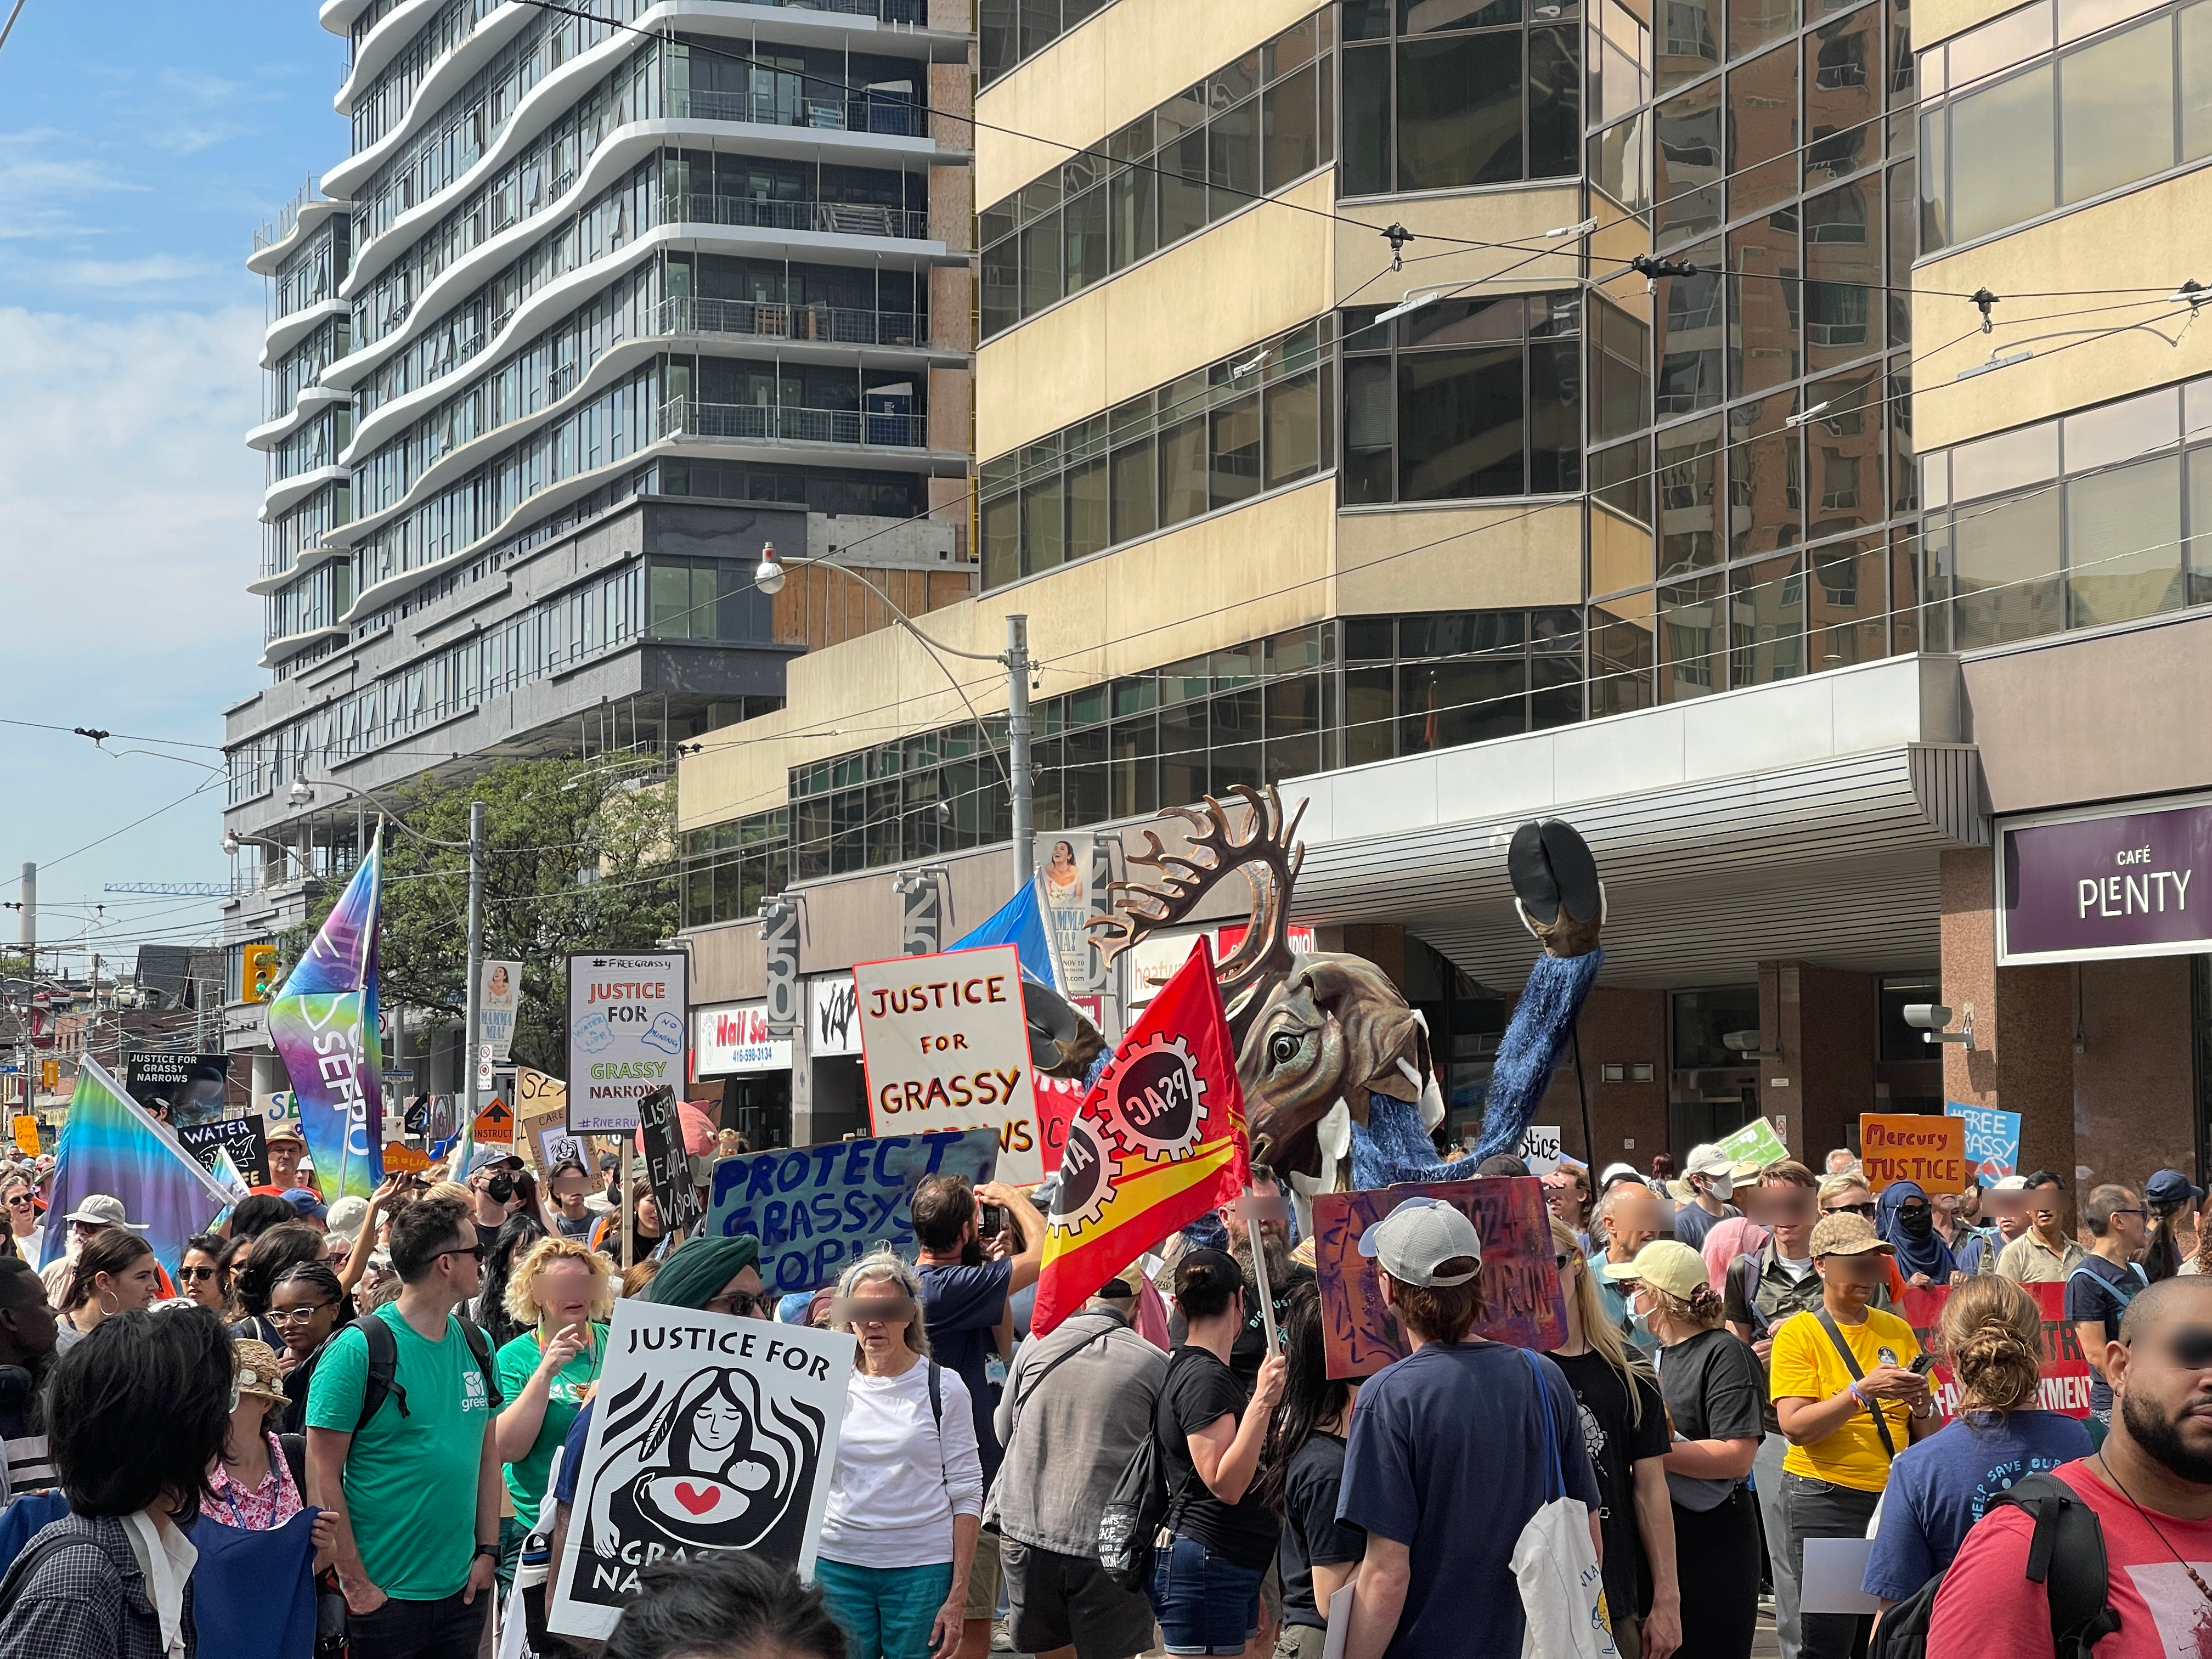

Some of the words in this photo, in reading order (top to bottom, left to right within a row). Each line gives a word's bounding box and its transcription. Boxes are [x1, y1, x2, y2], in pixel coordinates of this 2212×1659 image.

[2117, 845, 2151, 865] CAFÉ
[2078, 870, 2192, 919] PLENTY
[588, 983, 665, 1003] JUSTICE
[868, 976, 1007, 1019] JUSTICE
[481, 1011, 512, 1026] MAMMA
[608, 1006, 648, 1023] FOR
[662, 1019, 678, 1029] NO
[573, 1016, 603, 1037] WATER
[716, 1010, 747, 1047] Nail
[585, 1032, 607, 1047] LIFE
[649, 1028, 678, 1048] MINING
[920, 1033, 969, 1054] FOR
[131, 1054, 174, 1063] JUSTICE
[178, 1056, 197, 1064] FOR
[732, 1046, 772, 1063] 416-598-3134
[137, 1073, 188, 1082] NARROWS
[143, 1064, 184, 1073] GRASSY
[591, 1061, 667, 1080] GRASSY
[590, 1084, 668, 1099] NARROW
[880, 1065, 1022, 1115] GRASSY
[539, 1109, 565, 1126] CARE
[642, 1093, 677, 1129] LISTEN
[184, 1120, 250, 1144] WATER
[578, 1117, 641, 1128] #RIVERRU
[661, 1125, 673, 1144] TO
[1866, 1124, 1948, 1152] Mercury
[1519, 1129, 1560, 1161] stice
[1965, 1131, 2017, 1159] RASSY
[382, 1155, 398, 1165] TER
[531, 1146, 546, 1176] RESPECT
[714, 1131, 966, 1207] PROTECT
[1866, 1158, 1959, 1181] JUSTICE
[240, 1170, 261, 1186] FE
[656, 1182, 703, 1227] WISDOM
[627, 1326, 757, 1358] JUSTICE
[765, 1340, 831, 1381] FOR
[1972, 1483, 1987, 1522] HELP
[1987, 1460, 2022, 1482] SAVE
